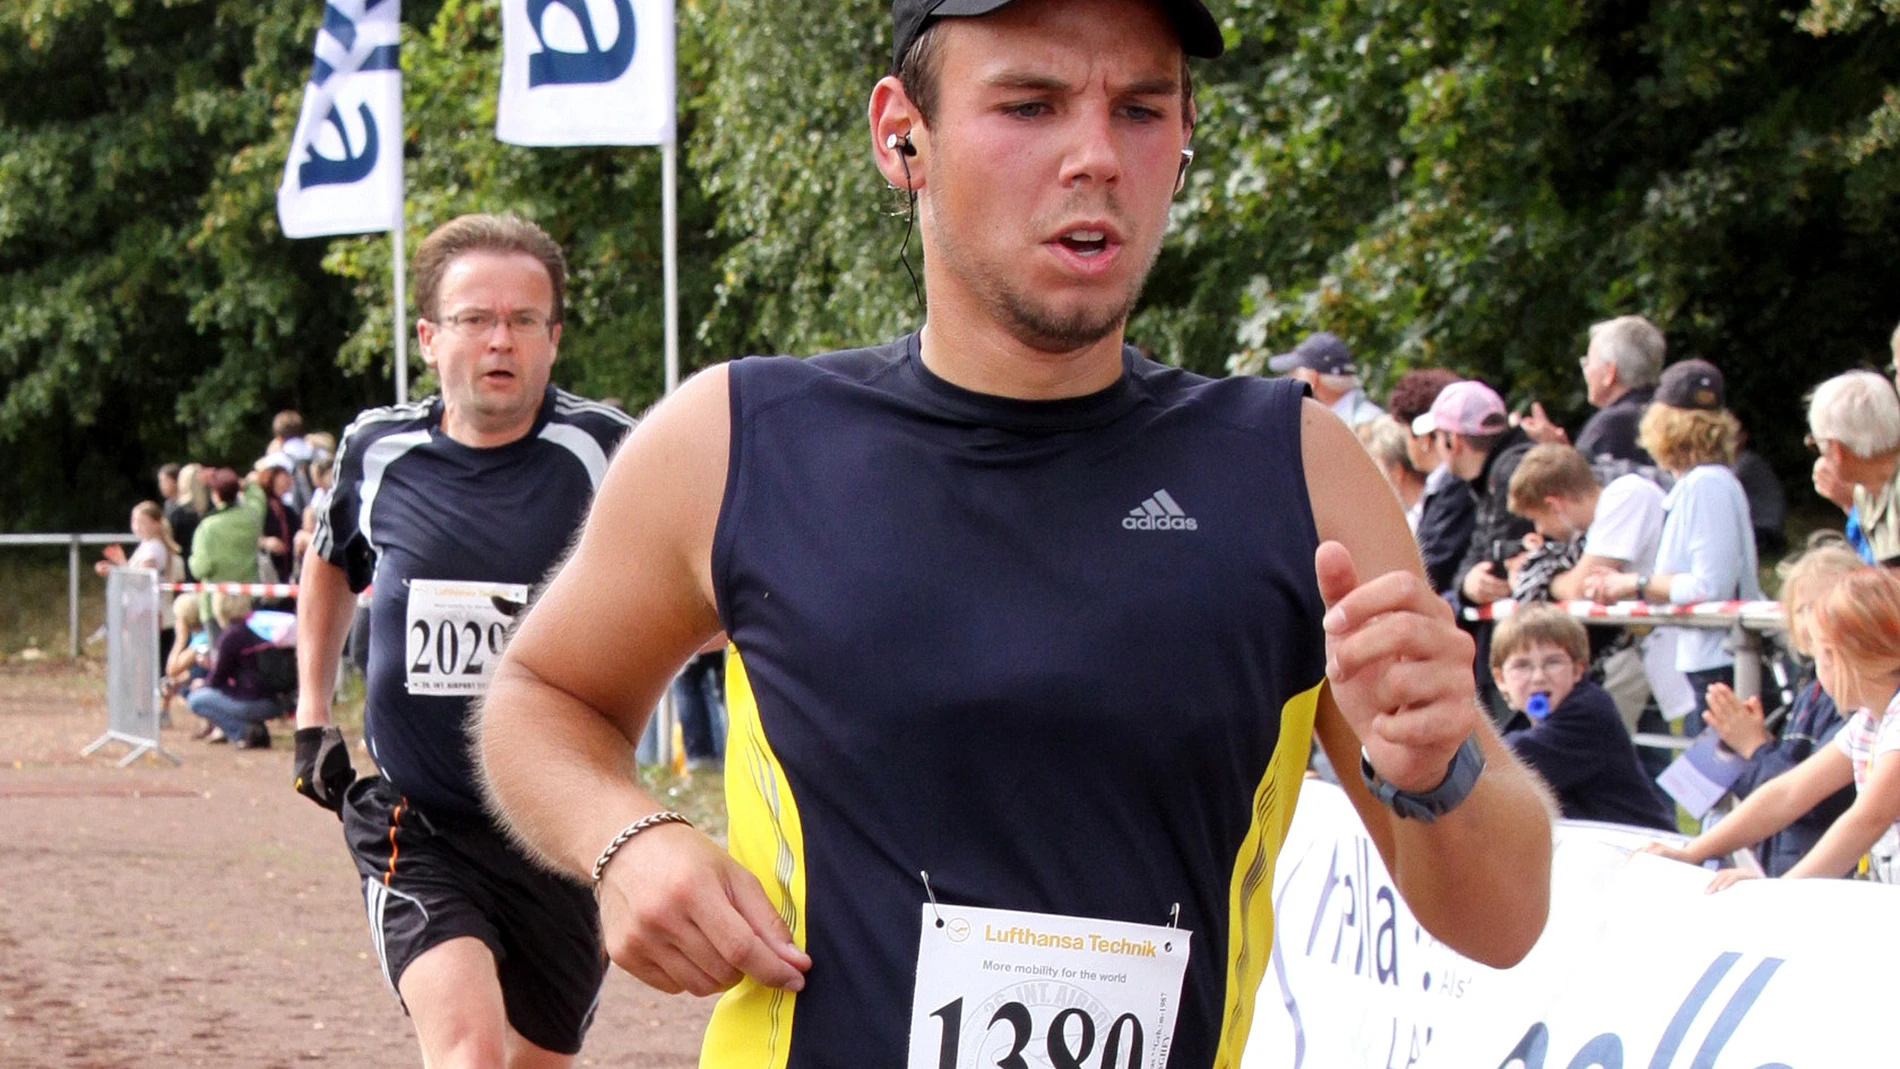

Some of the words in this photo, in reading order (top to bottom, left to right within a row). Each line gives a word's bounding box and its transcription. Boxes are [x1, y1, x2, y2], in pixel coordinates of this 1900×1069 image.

[1122, 514, 1198, 531] adidas
[985, 924, 1084, 950] Lufthansa
[1088, 934, 1157, 958] Technik
[982, 960, 1012, 973] More
[1014, 965, 1059, 979] mobility
[1061, 967, 1077, 980] for
[1080, 970, 1097, 981] the
[1099, 973, 1127, 984] world
